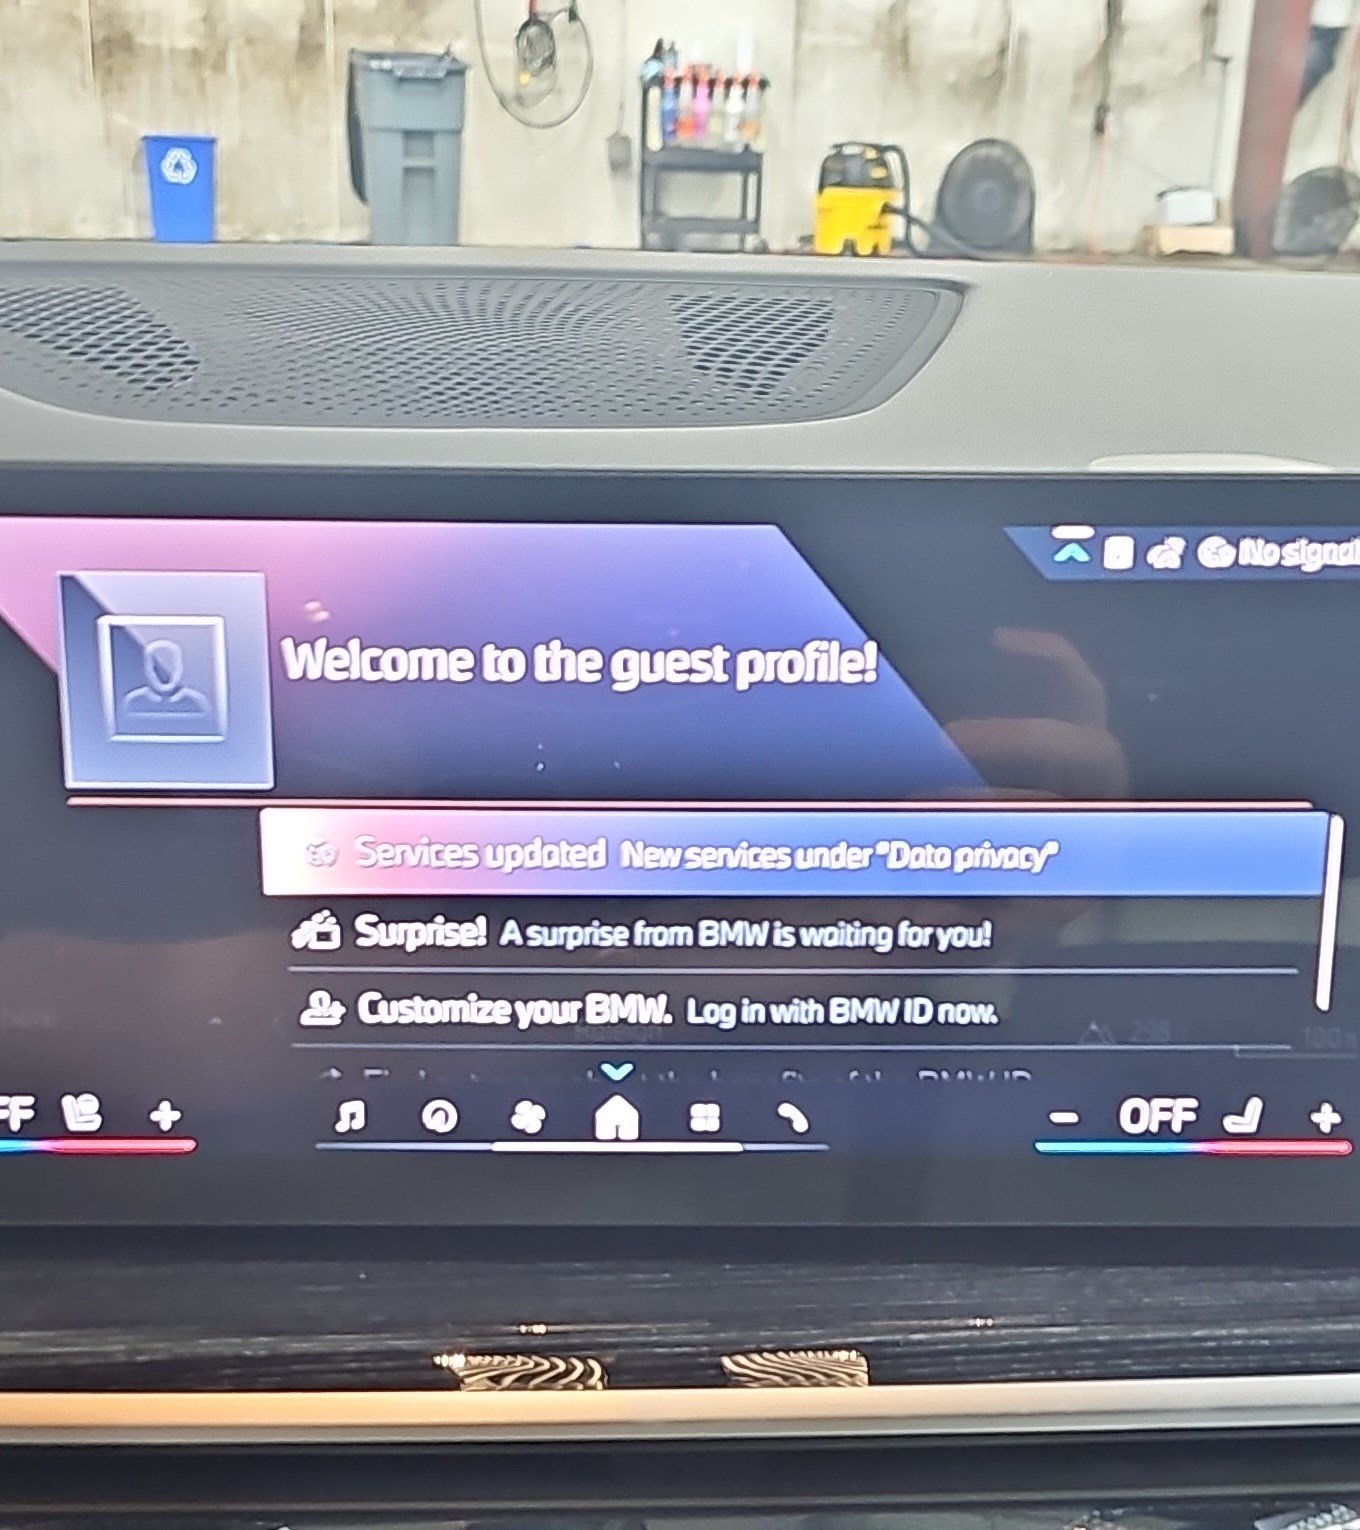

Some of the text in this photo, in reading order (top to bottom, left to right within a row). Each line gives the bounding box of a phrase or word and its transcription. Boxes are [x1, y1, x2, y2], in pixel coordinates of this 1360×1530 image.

[1238, 538, 1280, 567] No
[280, 637, 878, 692] Welcome to the guest profile!
[354, 835, 607, 873] Services updated
[620, 840, 683, 869] New
[684, 841, 792, 869] services
[794, 841, 874, 870] under
[354, 913, 487, 953] Surprise!
[499, 919, 993, 953] A surprise from BMW is waiting for you!
[357, 991, 673, 1030] Customize your BMW.
[687, 996, 999, 1029] Log in with BMW ID now.
[1119, 1097, 1199, 1134] OFF
